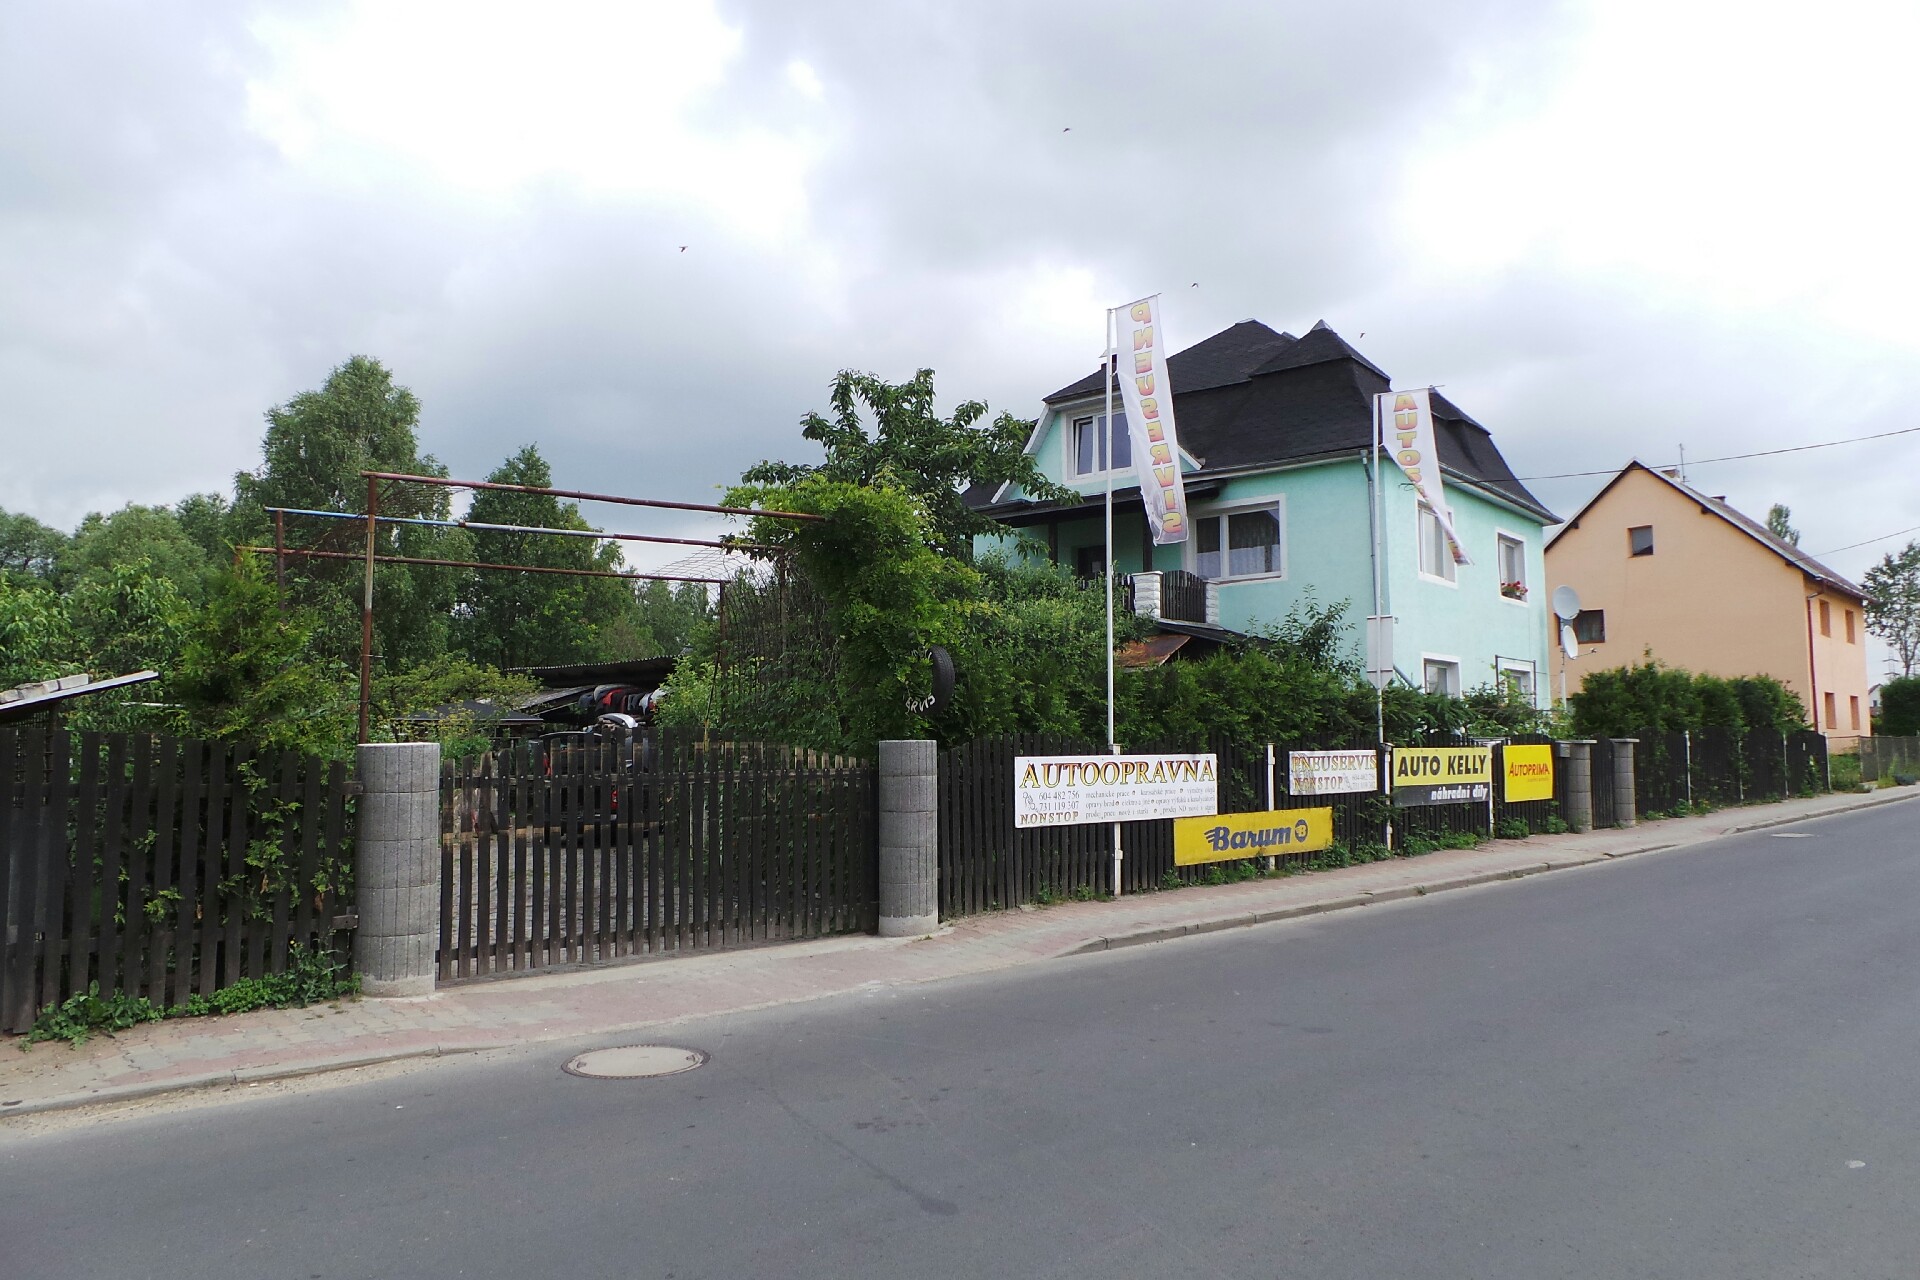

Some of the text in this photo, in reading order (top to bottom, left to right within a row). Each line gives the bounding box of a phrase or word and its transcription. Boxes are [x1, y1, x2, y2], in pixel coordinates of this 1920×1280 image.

[1019, 760, 1216, 788] AUTOOPRAVNA
[1292, 754, 1377, 773] PNEUSERVIS
[1397, 754, 1487, 777] AUTO KELLY
[1053, 791, 1066, 800] 482
[1067, 790, 1080, 799] 756
[1039, 802, 1051, 811] 731
[1053, 801, 1066, 811] 119
[1204, 826, 1292, 852] Barum
